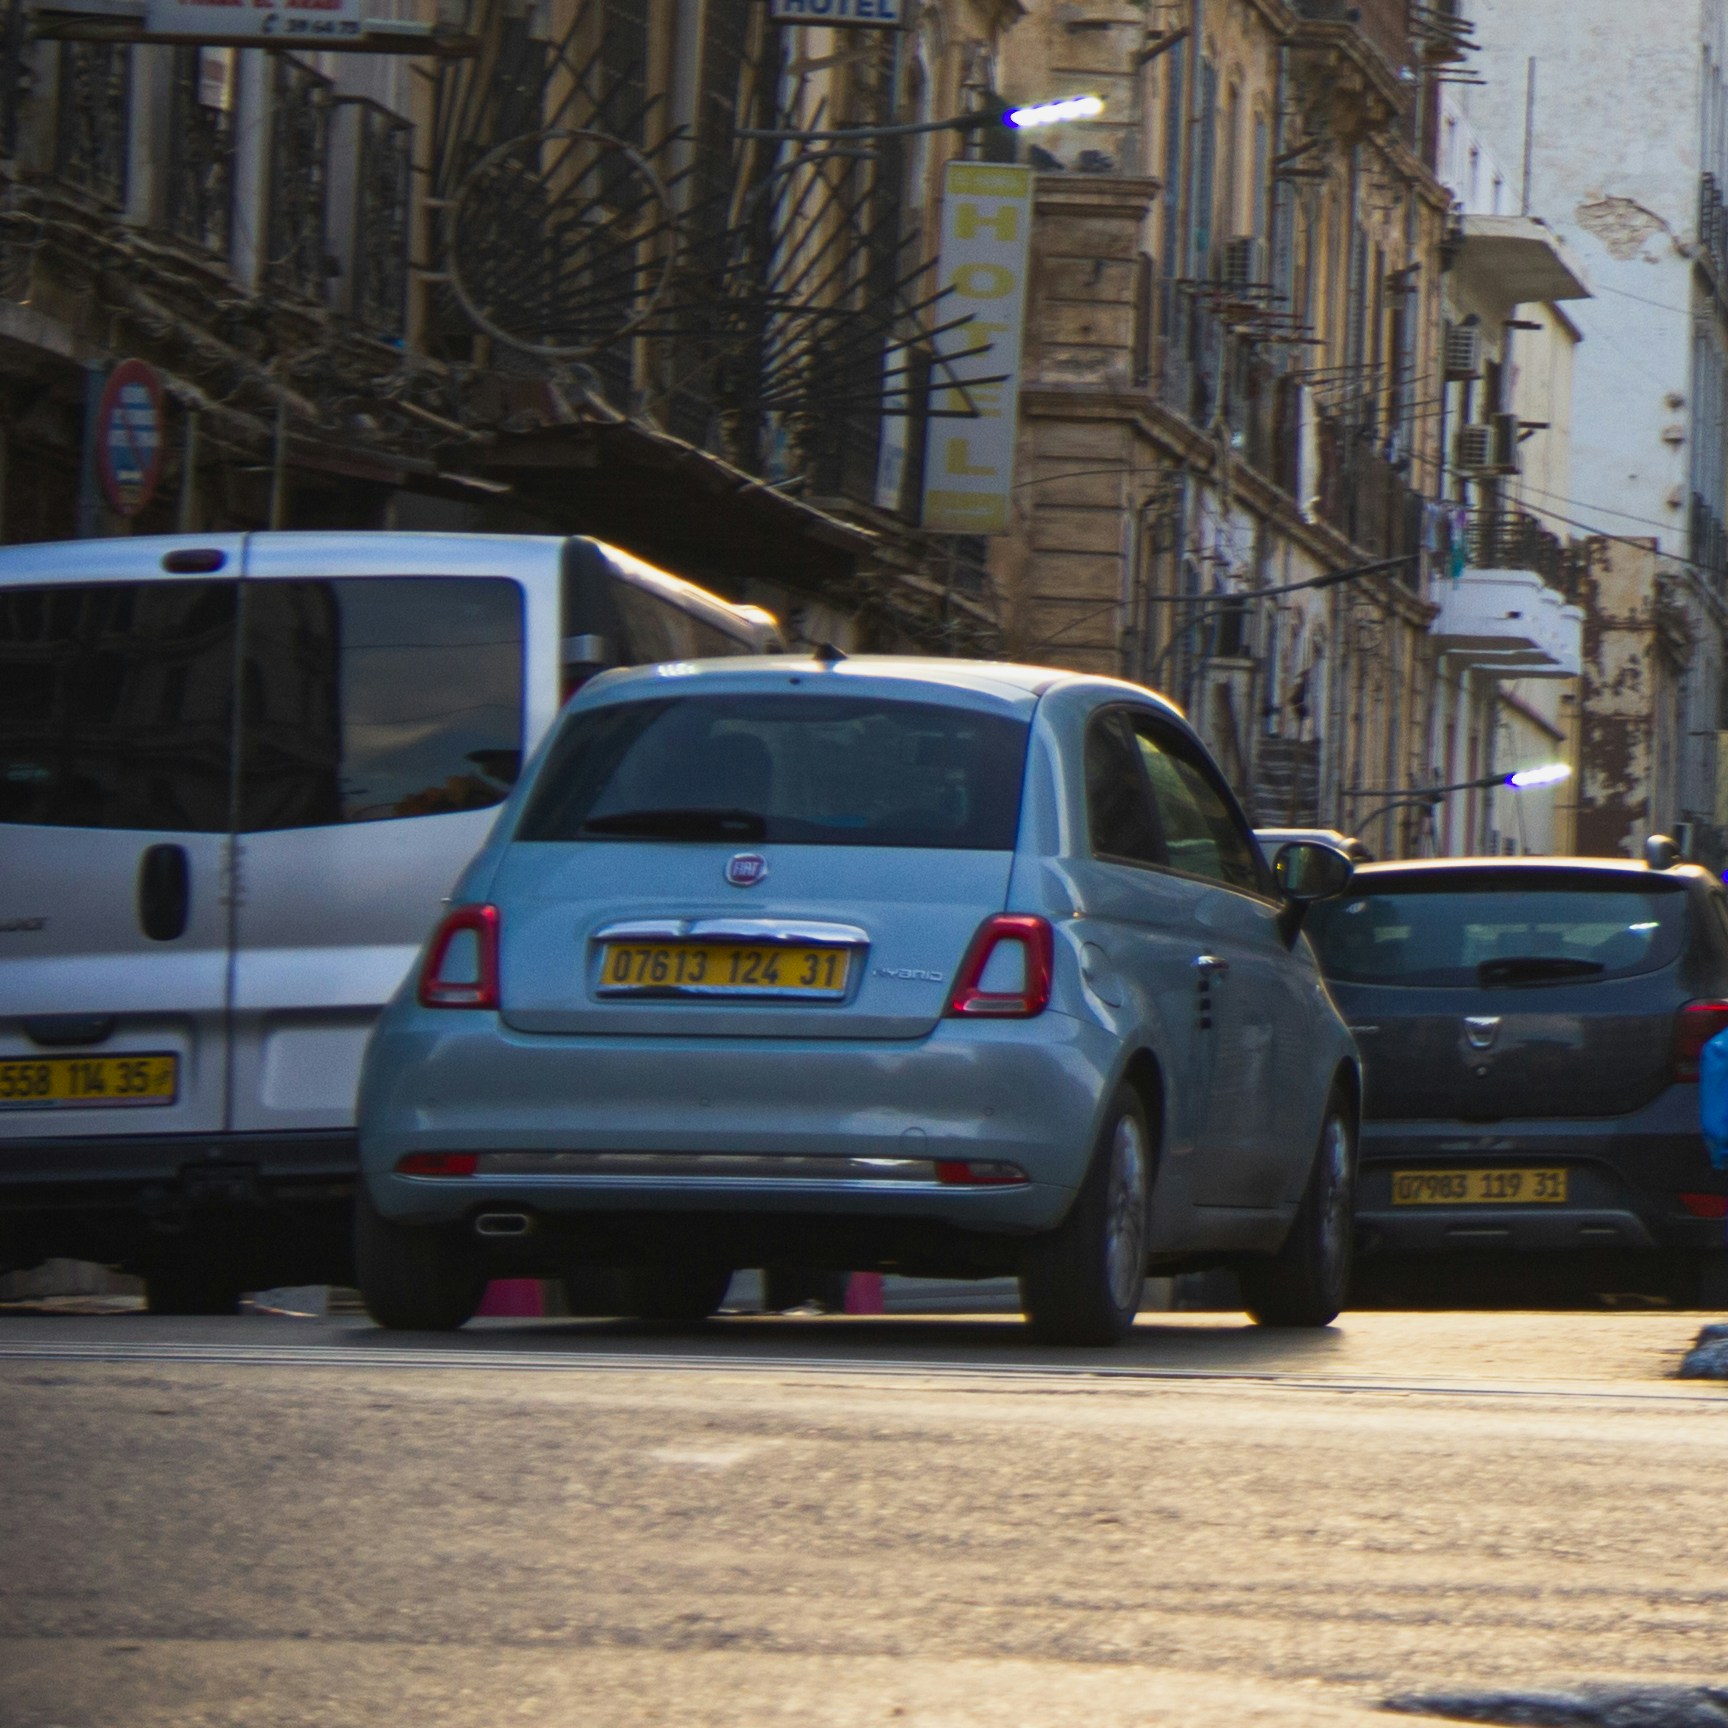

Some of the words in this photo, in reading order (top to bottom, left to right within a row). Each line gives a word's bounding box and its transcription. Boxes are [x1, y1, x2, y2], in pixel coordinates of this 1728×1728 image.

[944, 202, 1018, 477] HOTEL
[732, 861, 760, 876] FIAT
[611, 948, 706, 984] 07613
[727, 951, 779, 985] 124
[800, 953, 837, 986] 31
[117, 1060, 149, 1094] 35
[1480, 1174, 1524, 1198] 119
